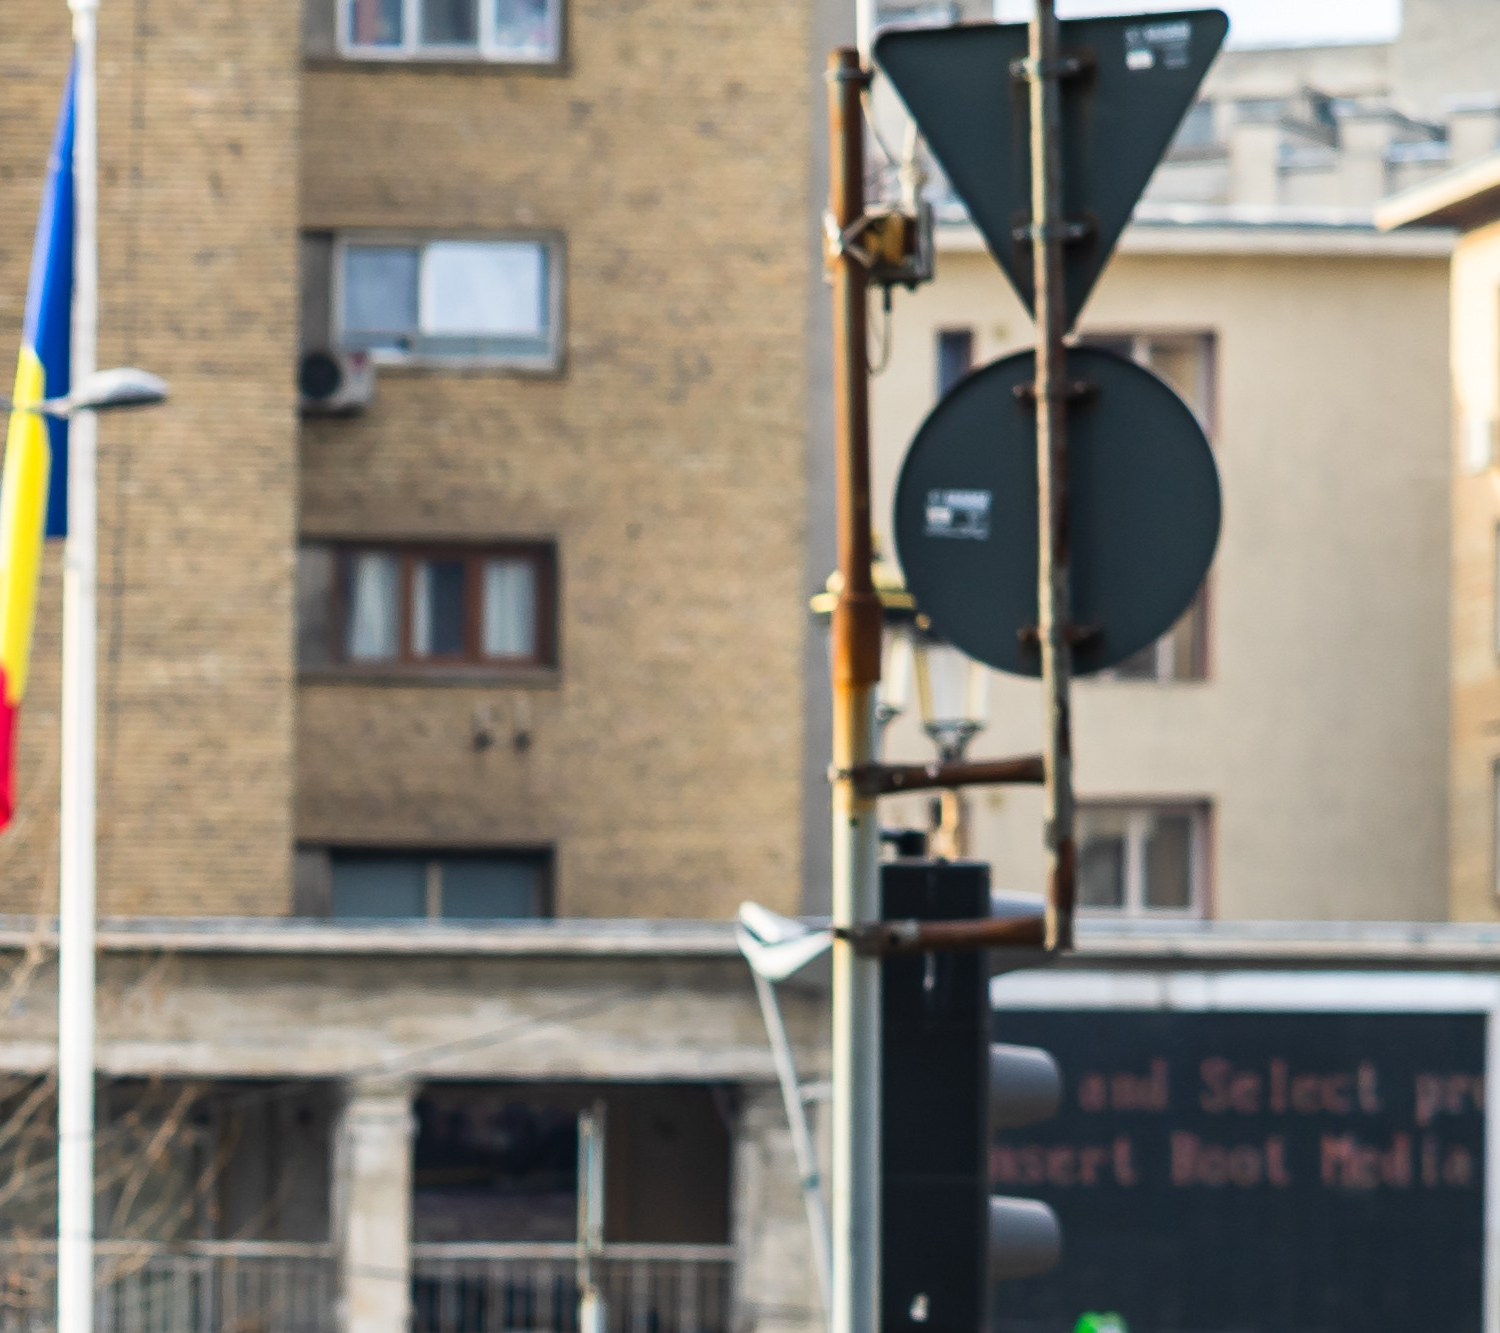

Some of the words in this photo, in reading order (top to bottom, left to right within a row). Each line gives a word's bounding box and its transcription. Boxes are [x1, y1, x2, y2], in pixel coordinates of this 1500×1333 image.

[1199, 1055, 1380, 1115] Select
[989, 1138, 1138, 1188] nsert
[1320, 1130, 1473, 1189] Media
